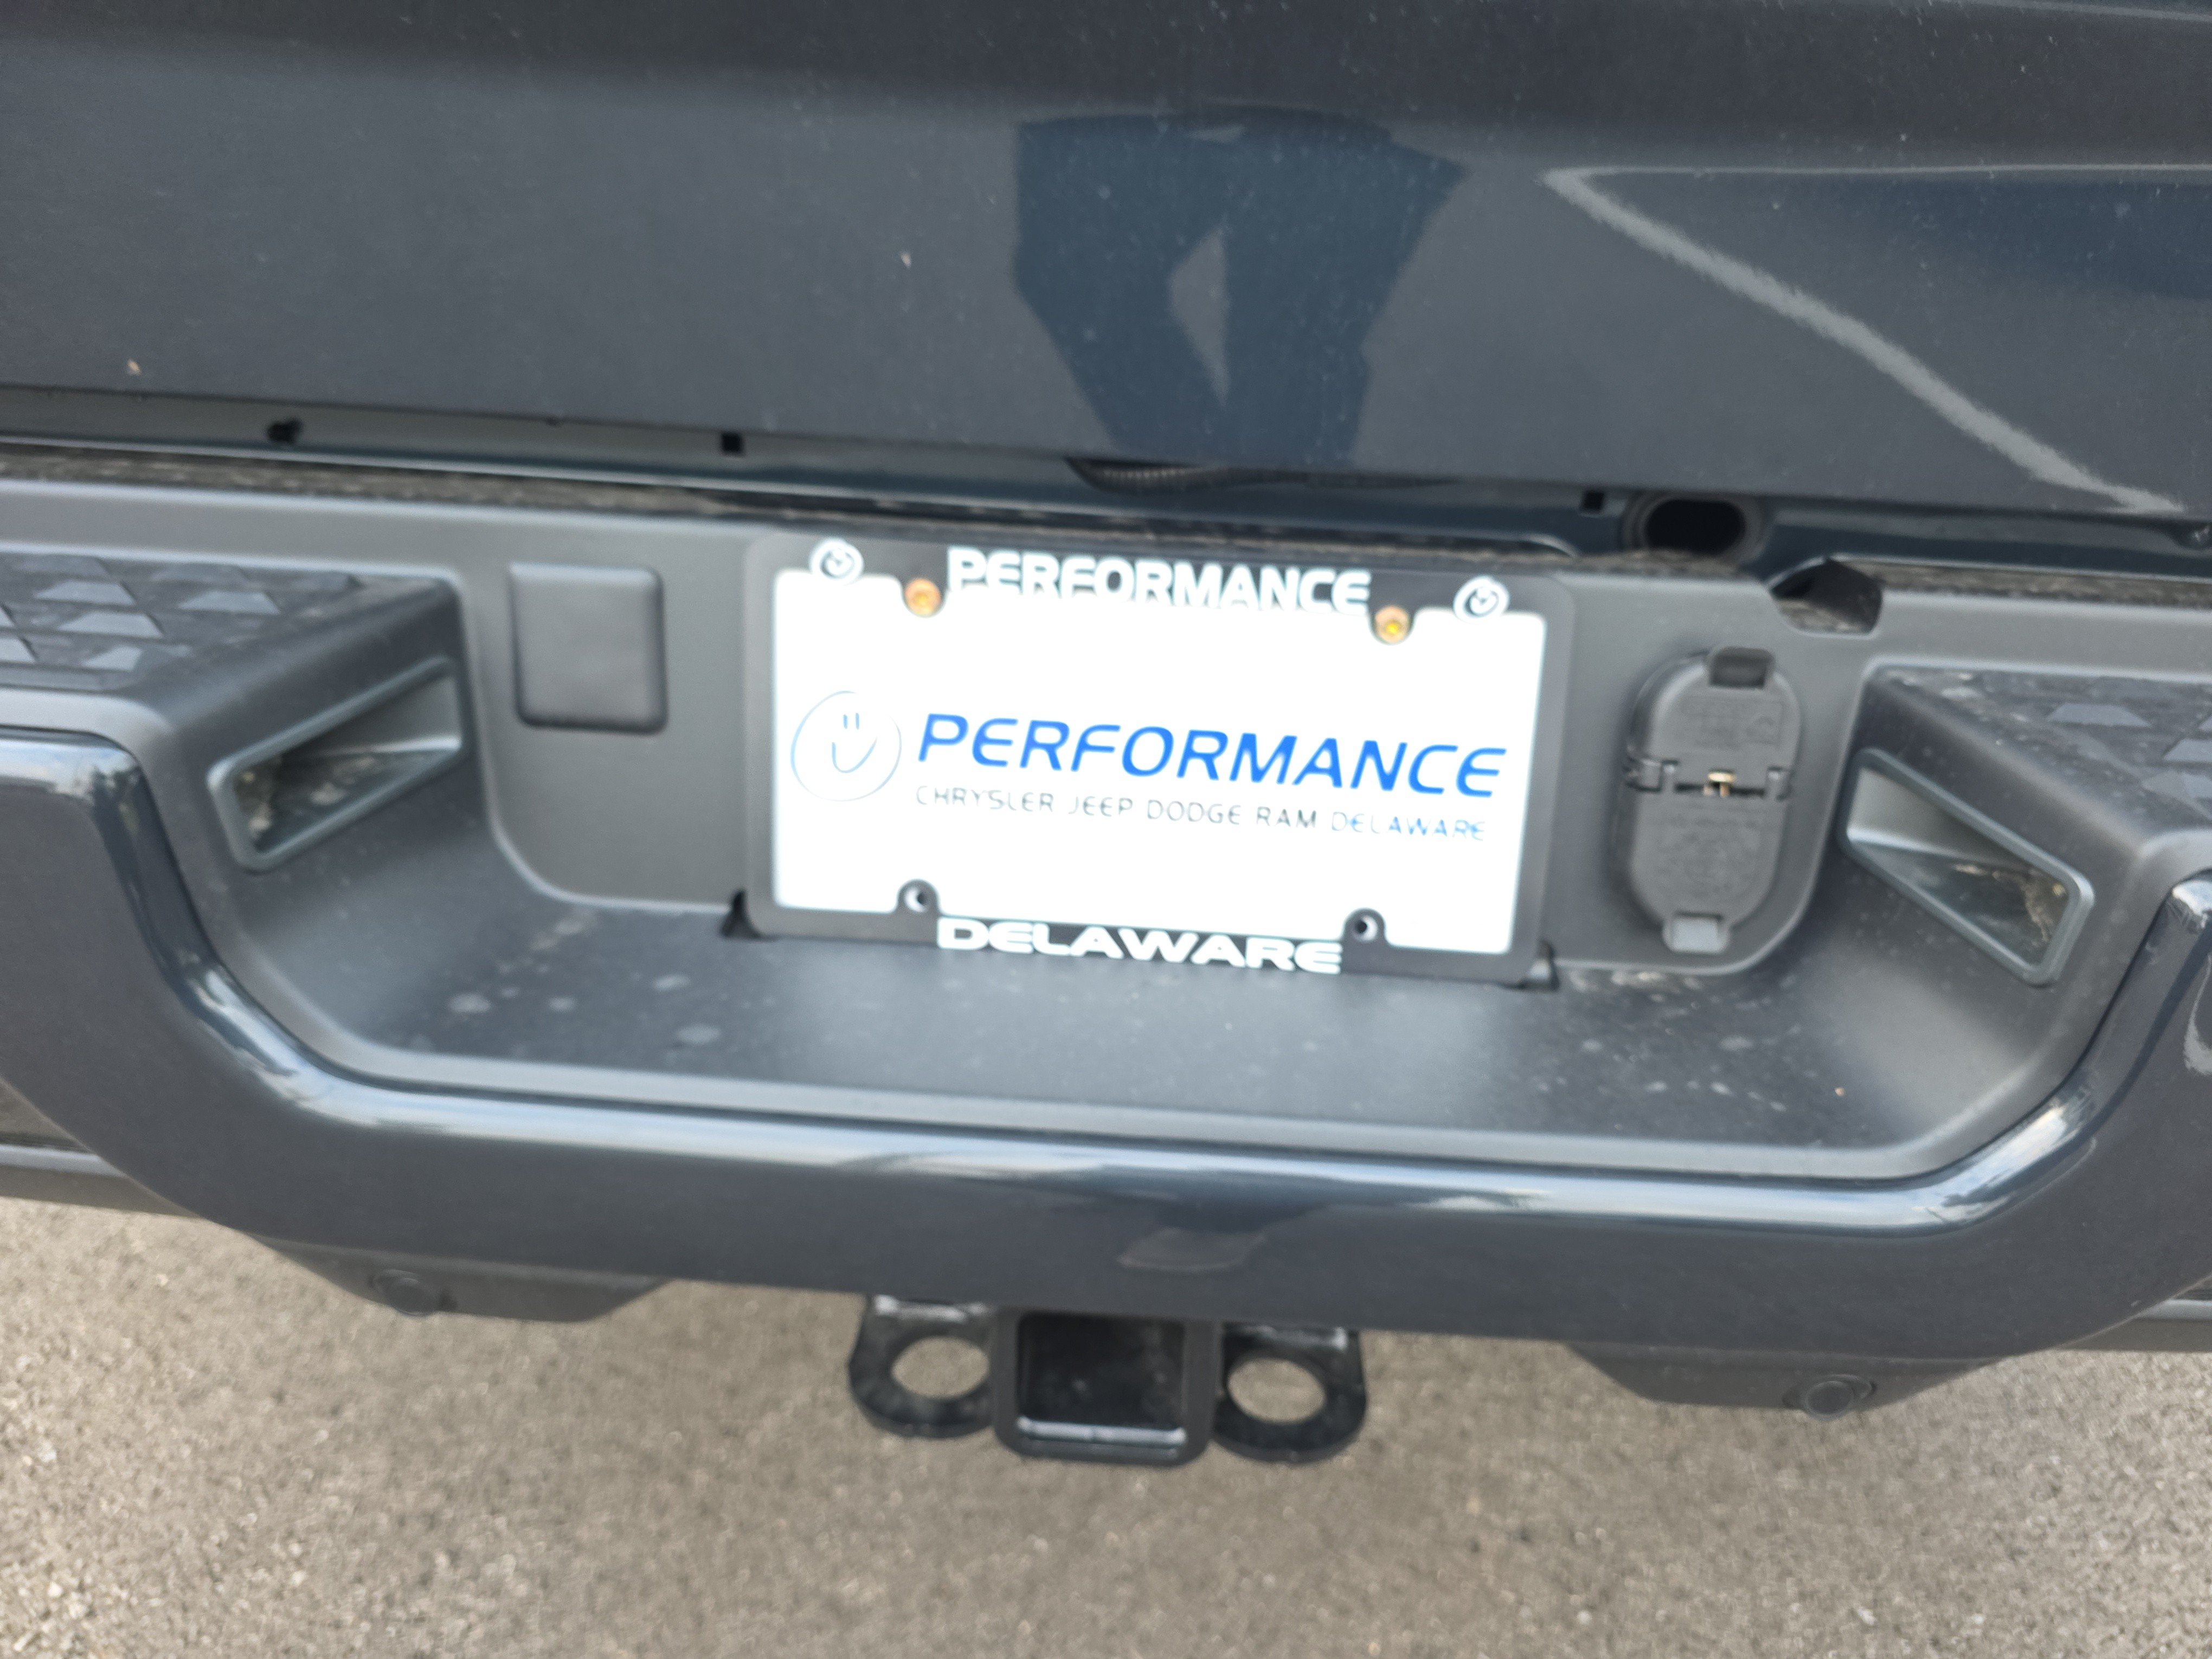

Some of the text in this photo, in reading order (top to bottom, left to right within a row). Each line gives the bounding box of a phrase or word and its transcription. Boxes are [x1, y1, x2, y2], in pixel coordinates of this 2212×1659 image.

[947, 546, 1372, 617] PERFORMANCE
[918, 713, 1507, 798] PERFORMANCE
[916, 785, 1487, 841] CHRYSLER JEEP DODGE RAM DELAWARE
[937, 916, 1343, 975] DELAWARE
